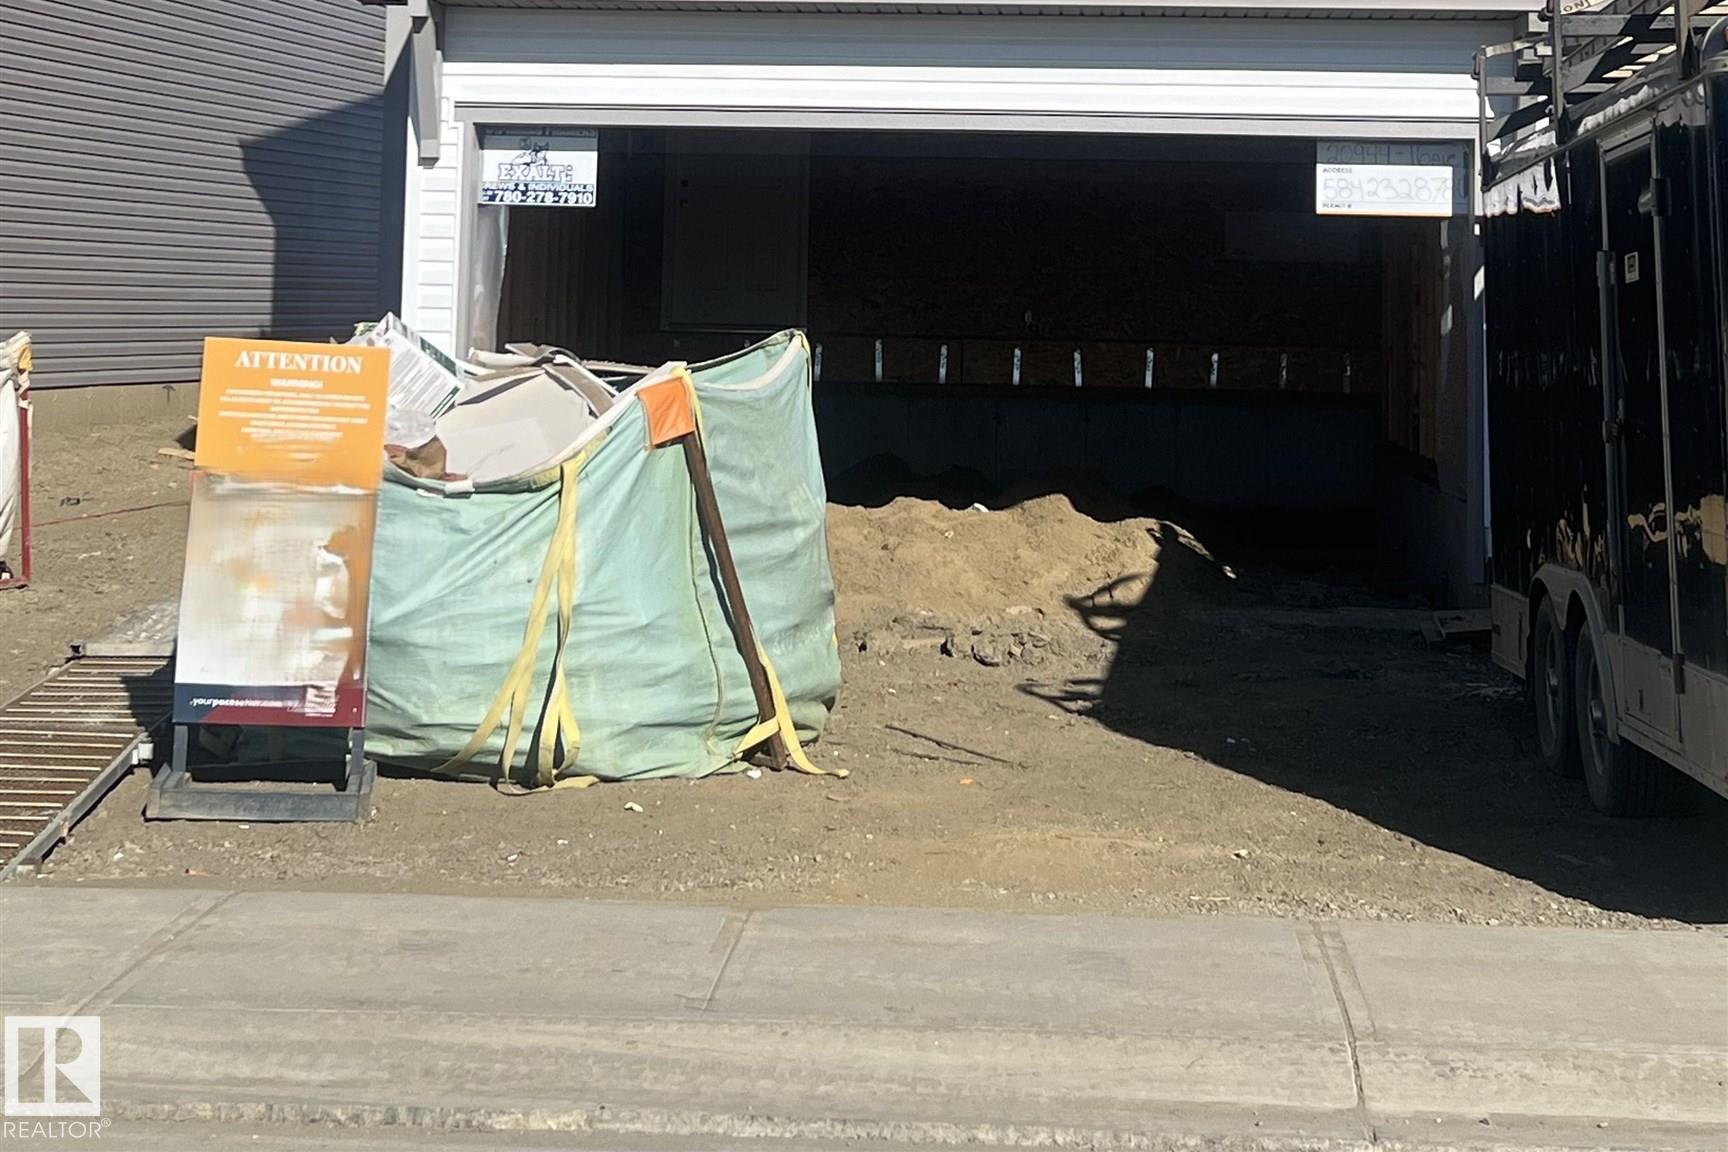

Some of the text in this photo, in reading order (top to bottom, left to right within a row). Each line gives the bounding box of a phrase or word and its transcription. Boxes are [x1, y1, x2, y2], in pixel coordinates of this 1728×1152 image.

[498, 163, 566, 181] EXALT
[494, 191, 594, 205] 780-278-7910
[234, 350, 363, 374] ATTENTION
